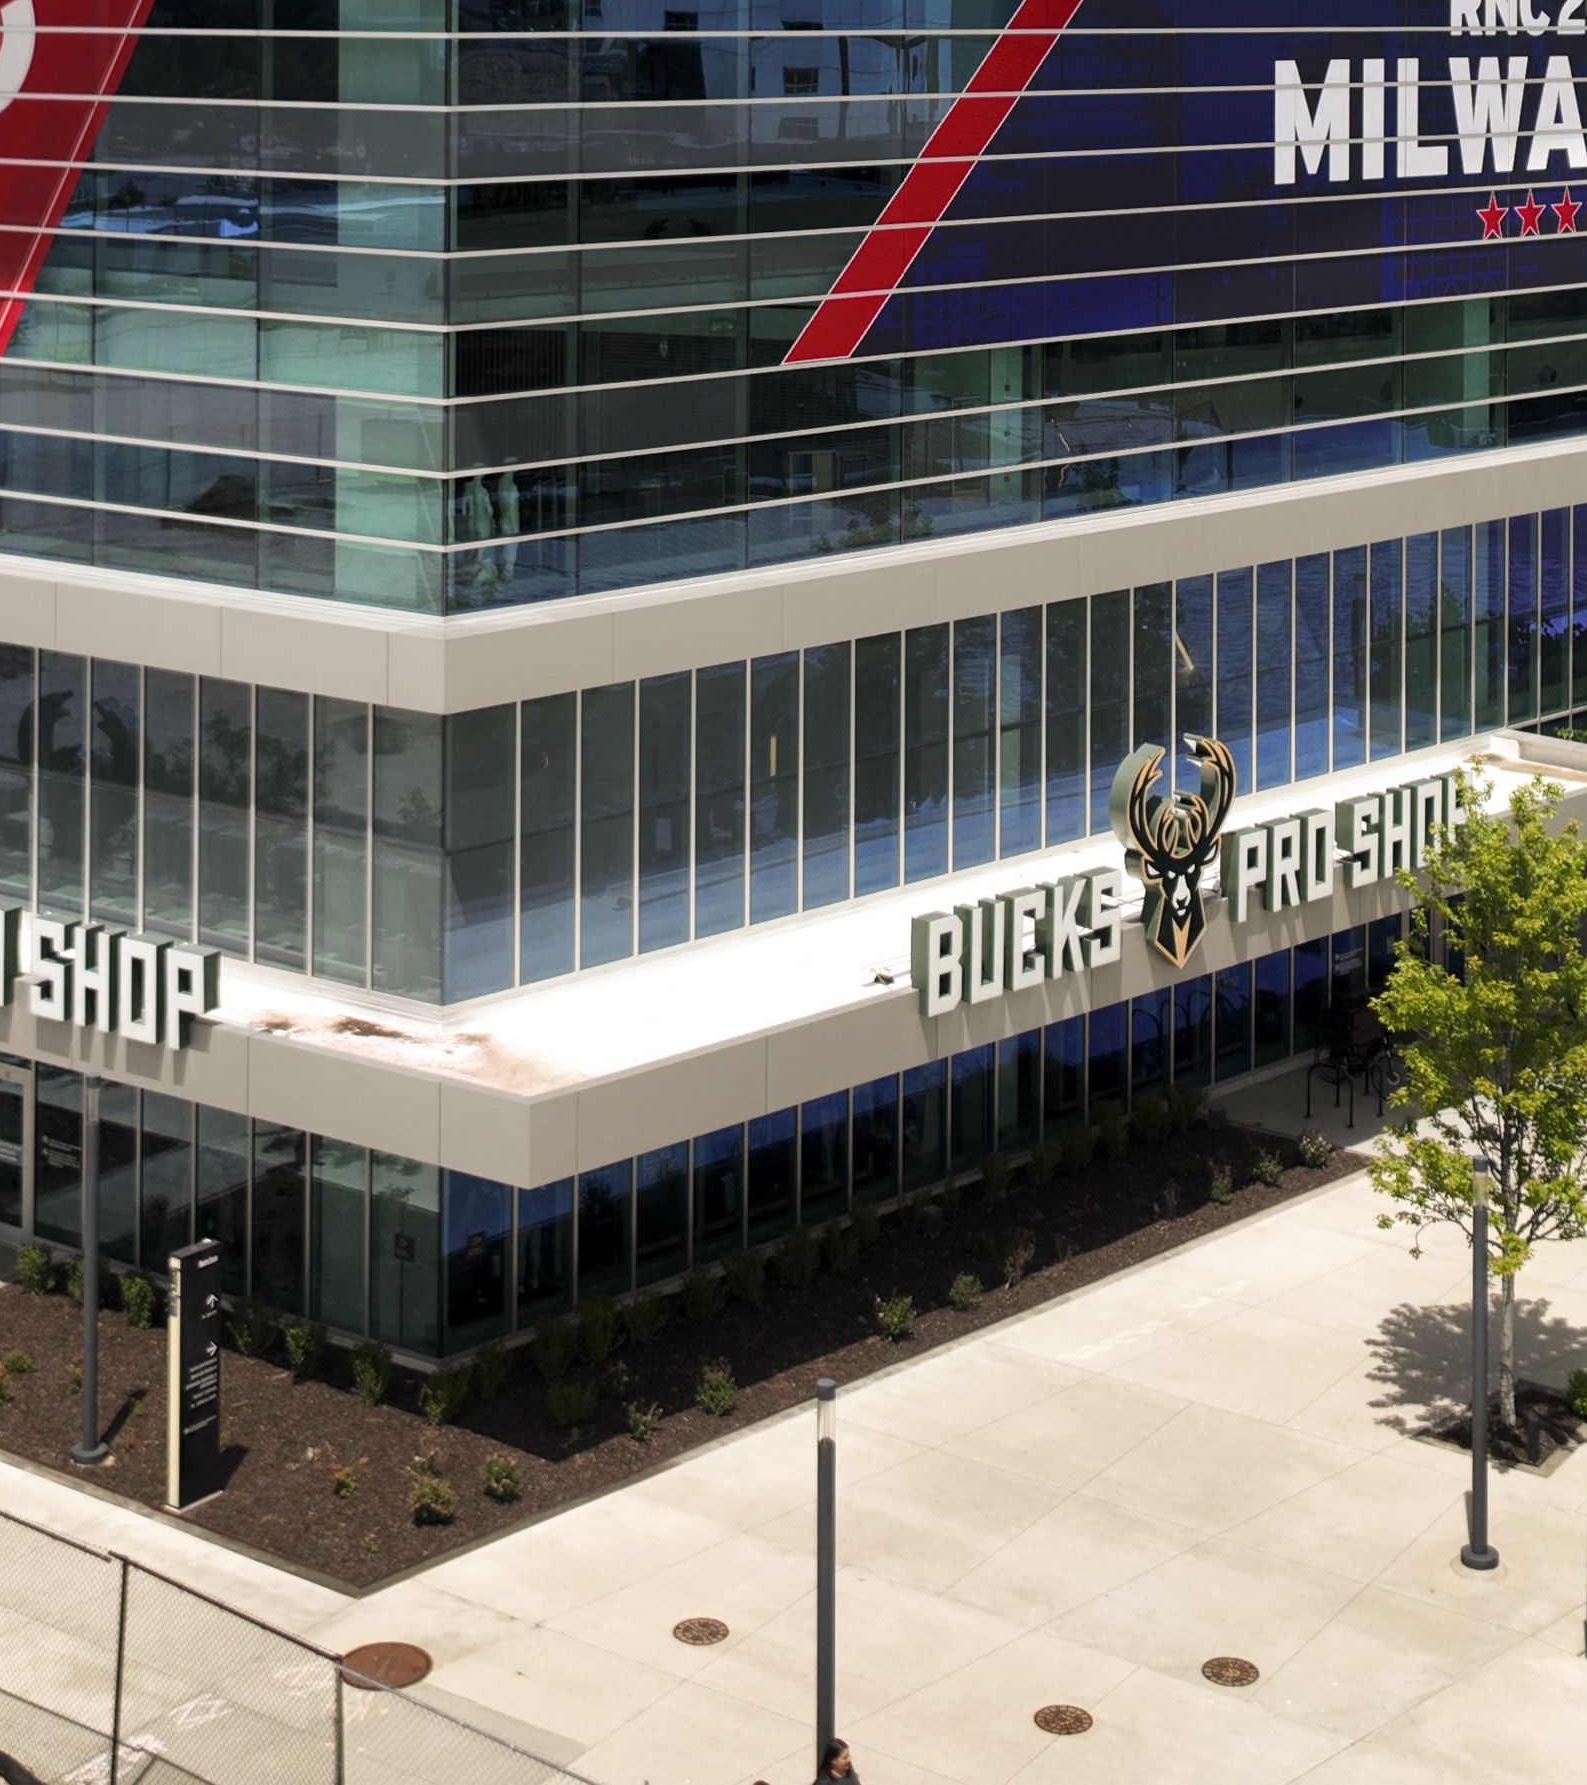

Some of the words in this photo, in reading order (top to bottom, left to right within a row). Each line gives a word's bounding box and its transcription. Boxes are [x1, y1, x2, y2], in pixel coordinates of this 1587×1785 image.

[29, 918, 215, 1050] SHOP
[917, 870, 1122, 1018] BUCKS
[1228, 809, 1335, 924] PRO
